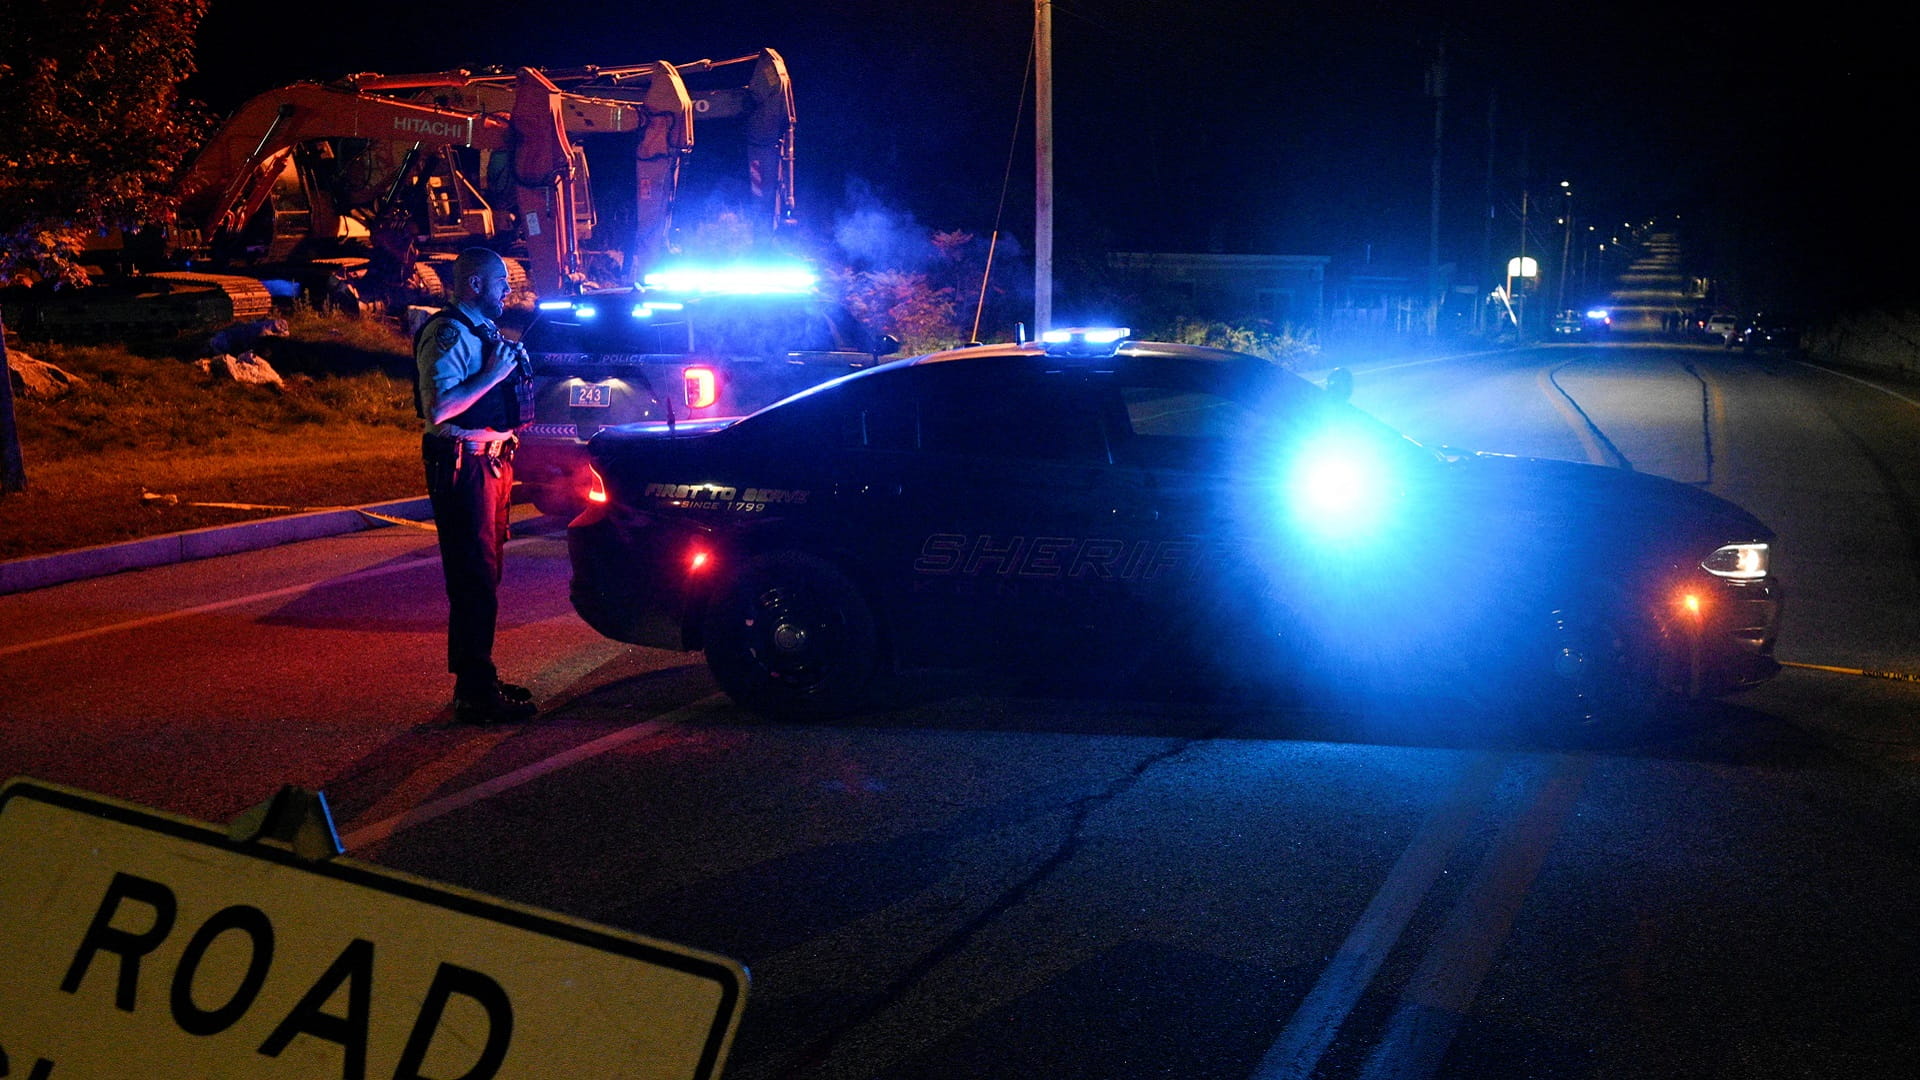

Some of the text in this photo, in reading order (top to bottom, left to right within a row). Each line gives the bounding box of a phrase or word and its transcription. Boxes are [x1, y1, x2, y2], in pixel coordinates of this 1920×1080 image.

[393, 116, 462, 138] HITACHI
[543, 353, 647, 363] STATE POLICE
[579, 388, 601, 402] 243
[645, 483, 704, 499] FIRST
[709, 485, 737, 501] TO
[680, 500, 766, 512] SINCE 1799
[60, 871, 513, 1080] ROAD
